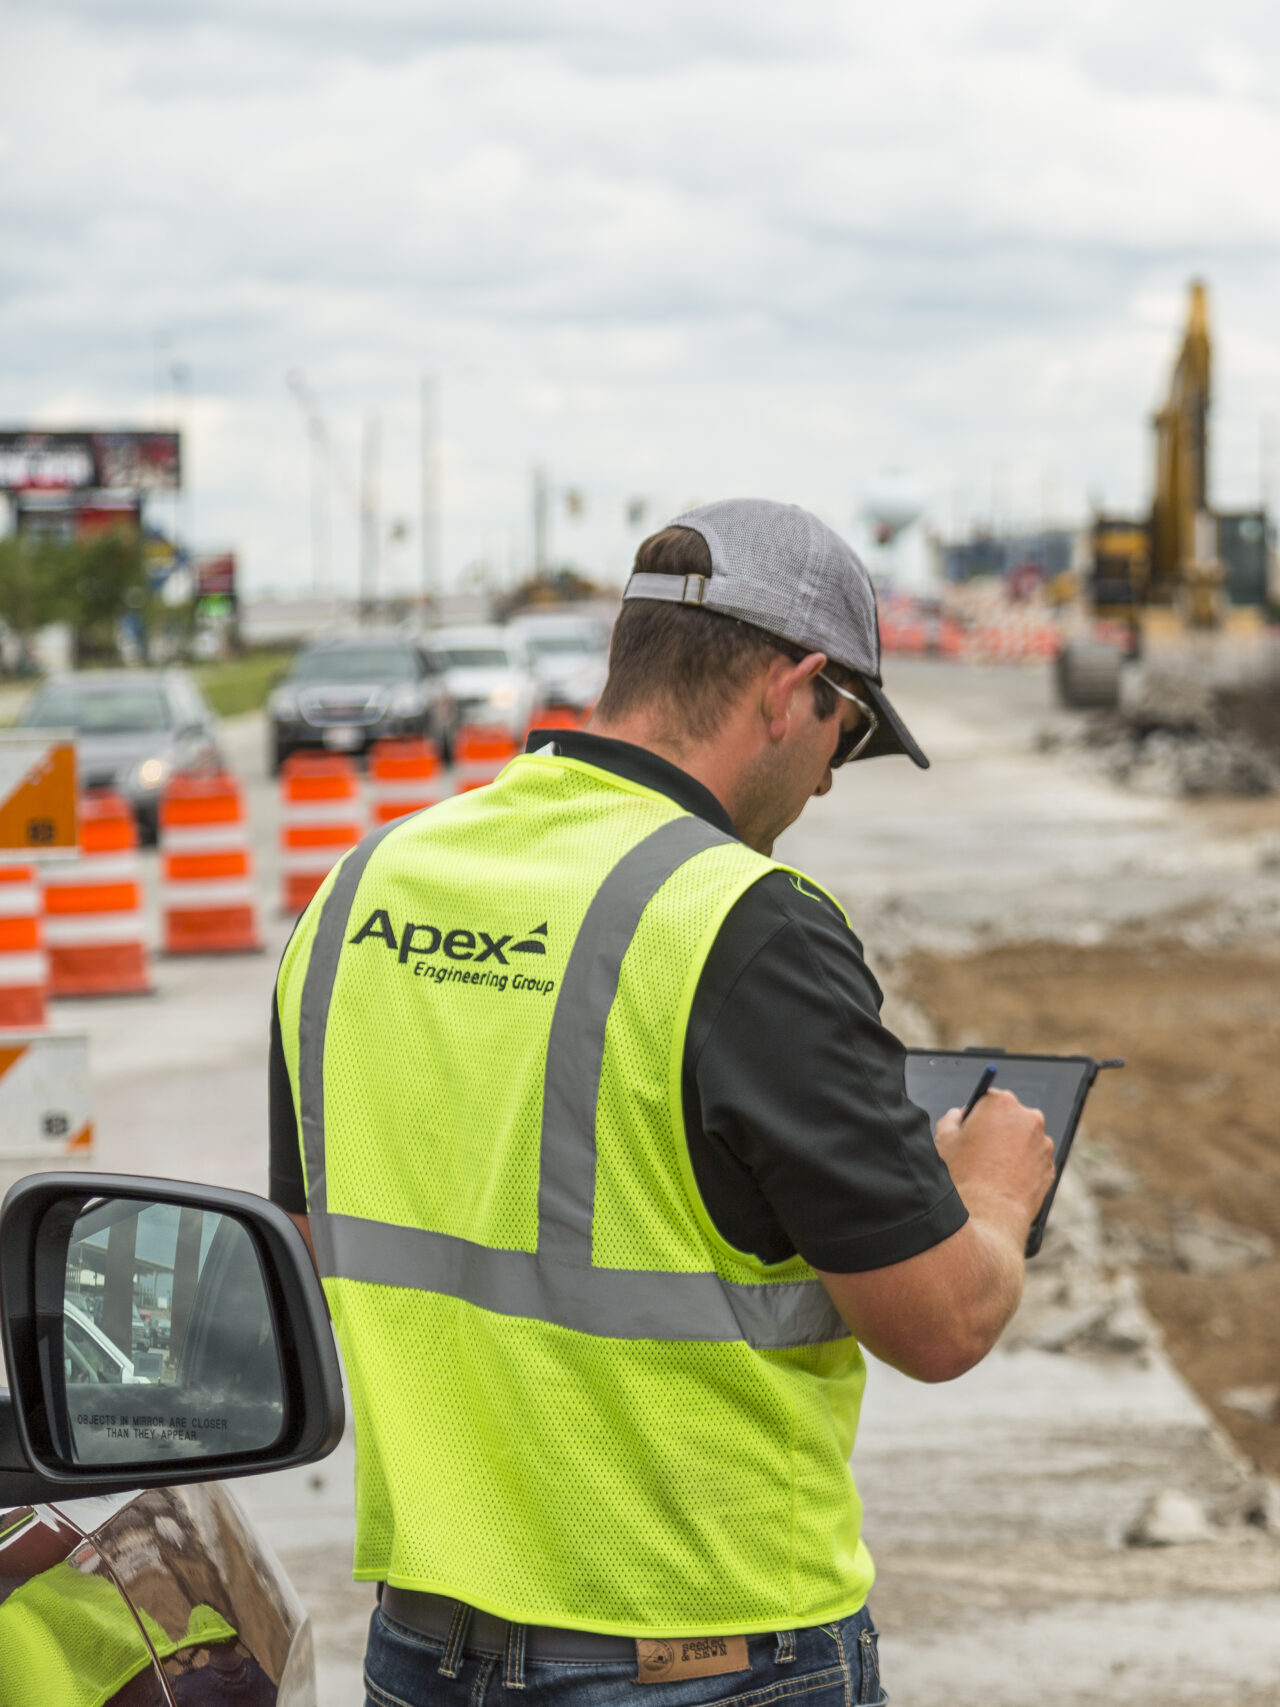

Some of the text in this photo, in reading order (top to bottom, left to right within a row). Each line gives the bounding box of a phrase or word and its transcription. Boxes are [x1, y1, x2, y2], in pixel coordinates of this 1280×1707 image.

[349, 909, 514, 965] Apex
[414, 961, 555, 996] Engineering Group
[77, 1414, 228, 1430] OBJECTS IN MIRROR ARE CLOSER
[106, 1427, 198, 1441] THAN THEY APPEAR
